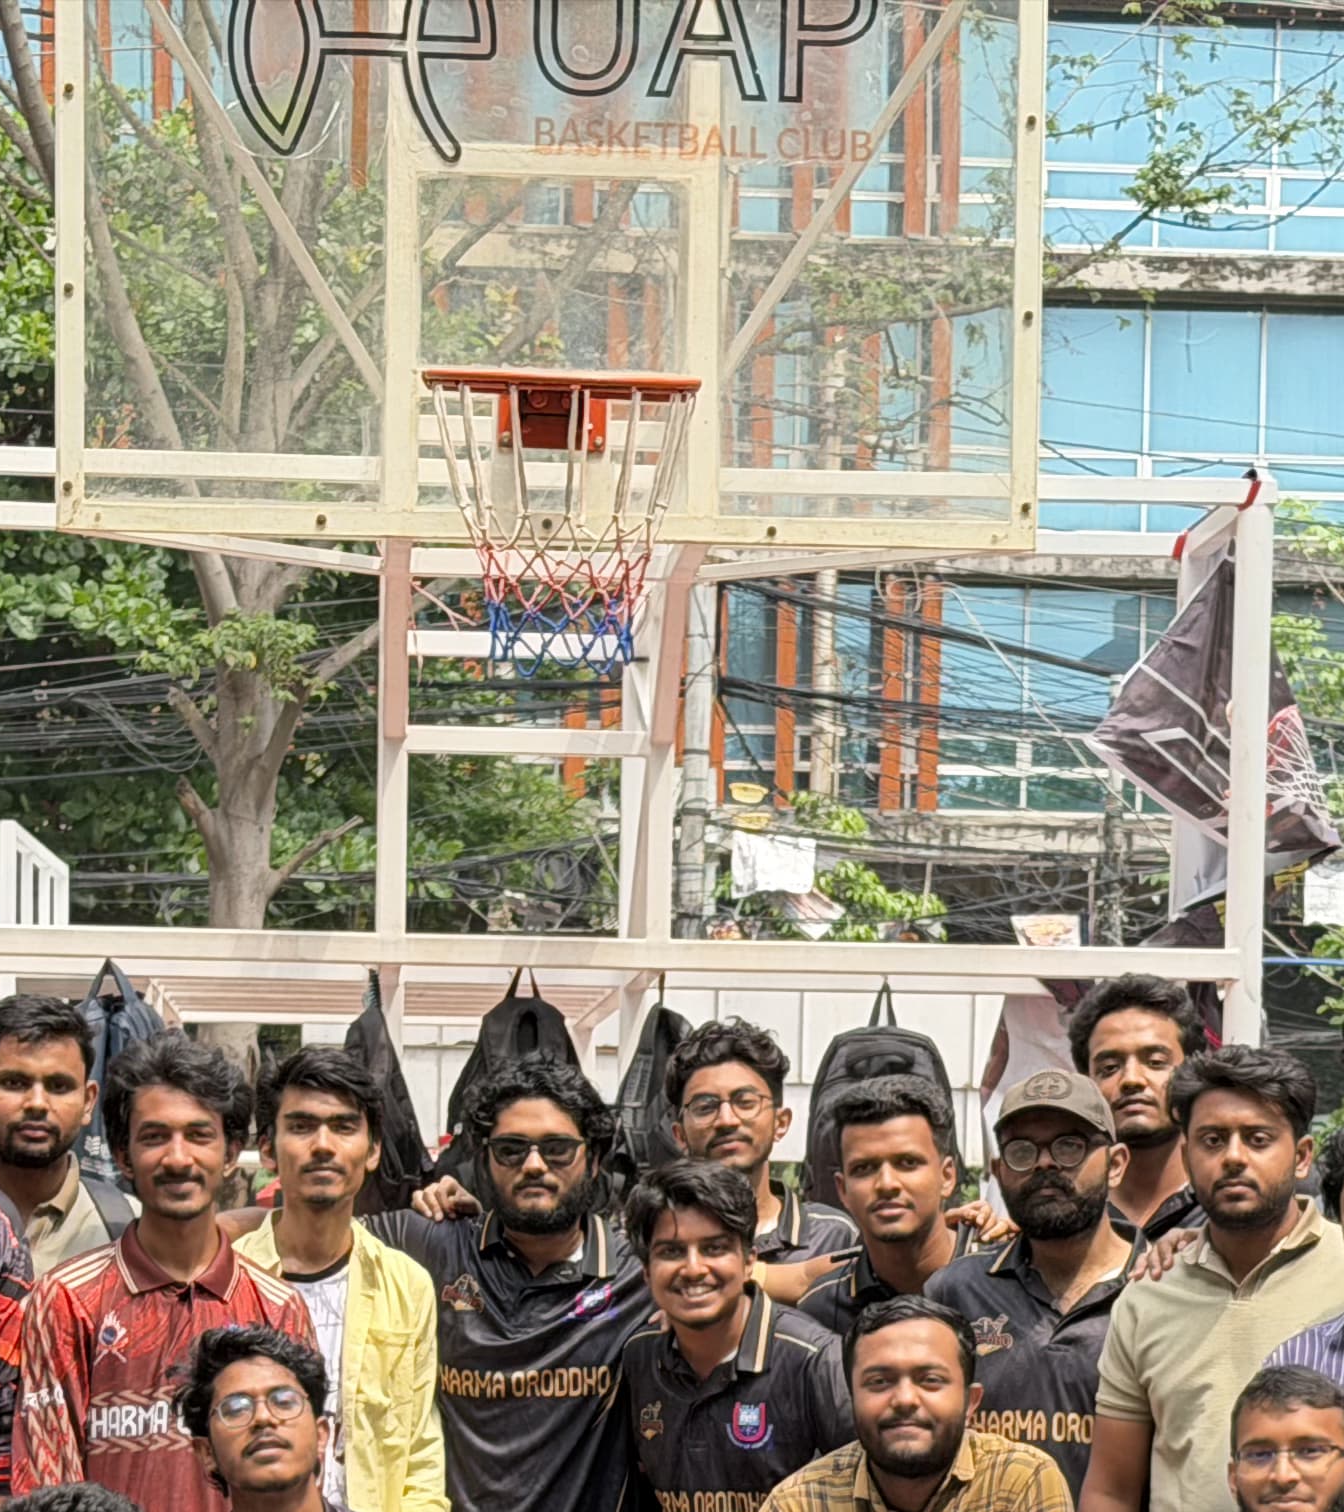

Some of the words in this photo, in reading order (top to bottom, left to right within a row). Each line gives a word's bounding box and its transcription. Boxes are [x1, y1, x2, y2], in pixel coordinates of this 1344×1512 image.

[533, 0, 877, 102] UAP
[534, 115, 769, 161] BASKETBALL
[776, 126, 873, 163] CLUB
[440, 1368, 506, 1398] HARMA
[511, 1366, 611, 1398] ORODDHO
[90, 1400, 169, 1438] HARMA
[973, 1409, 1047, 1441] HARMA
